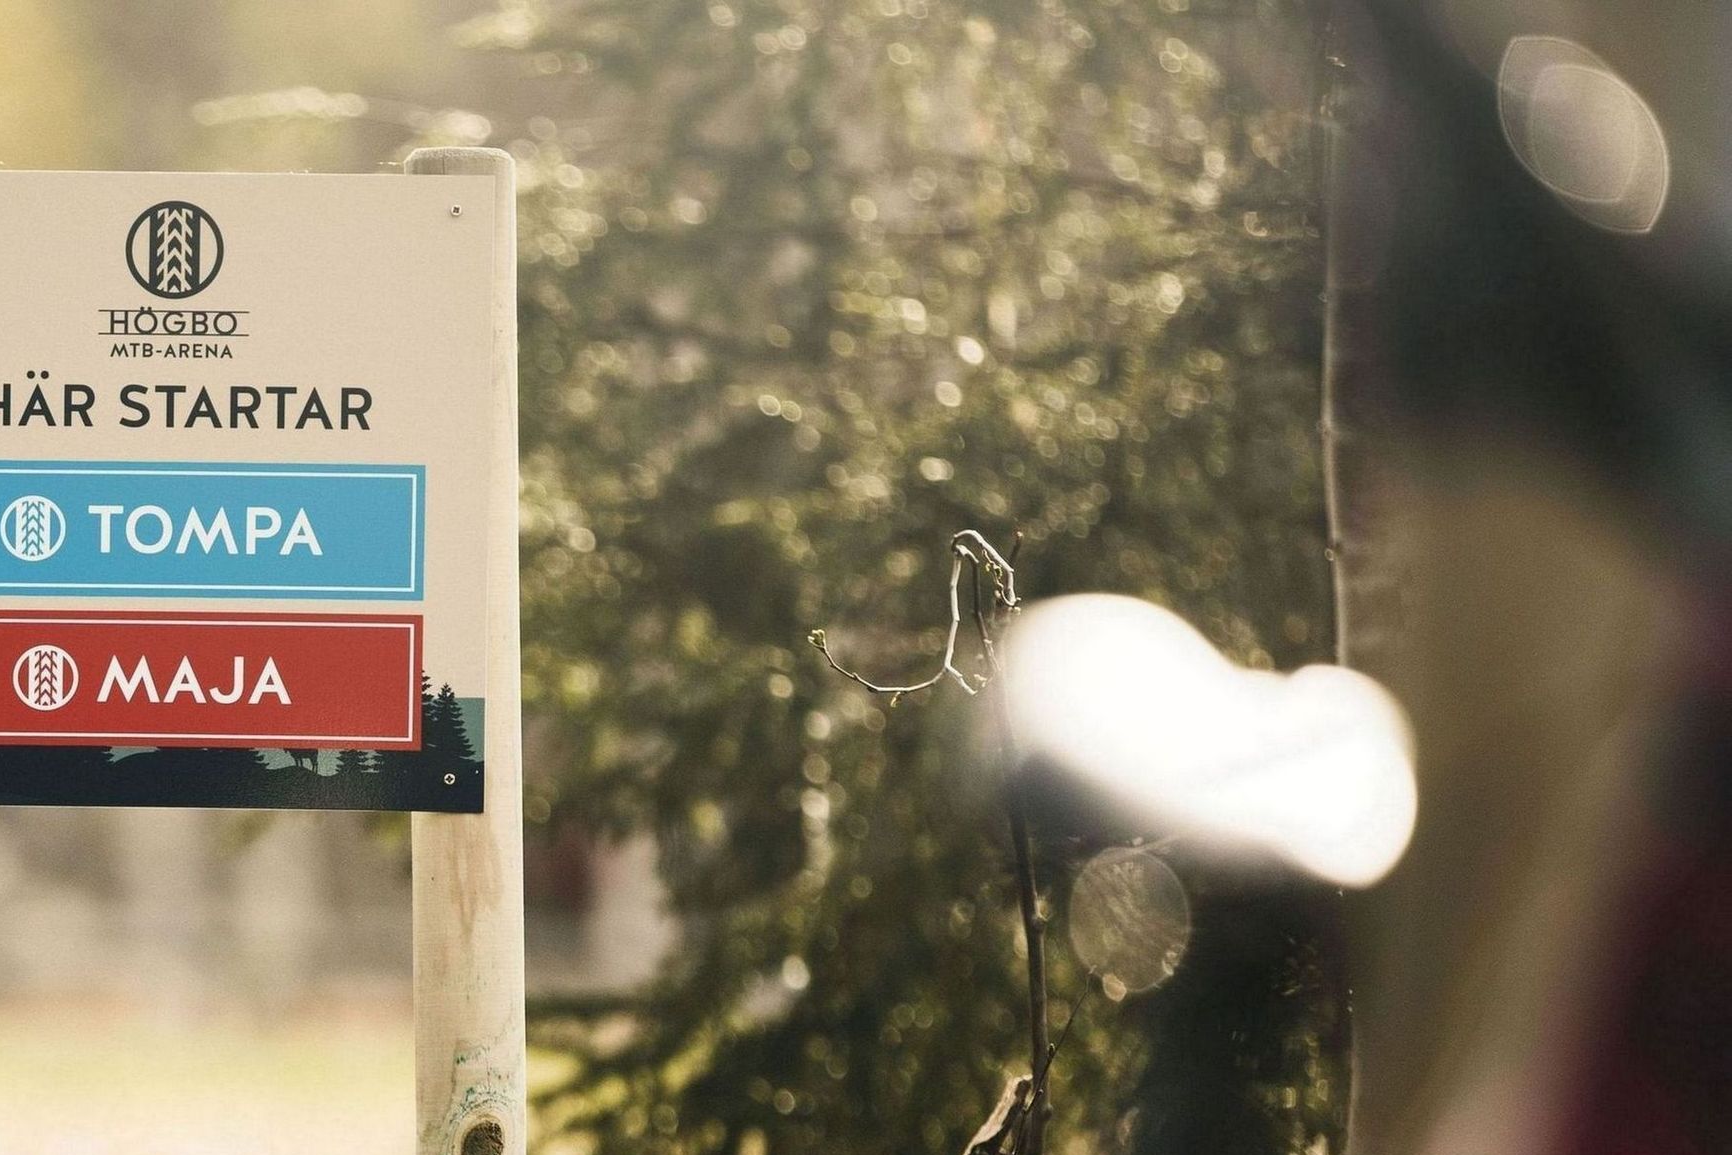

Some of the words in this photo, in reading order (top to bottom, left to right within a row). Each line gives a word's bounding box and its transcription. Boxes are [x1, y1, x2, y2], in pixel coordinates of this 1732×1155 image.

[110, 306, 237, 335] HÖGBO
[110, 342, 233, 359] MTB-ARENA
[119, 384, 373, 431] STARTAR
[88, 505, 324, 556] TOMPA
[96, 654, 292, 705] MAJA
